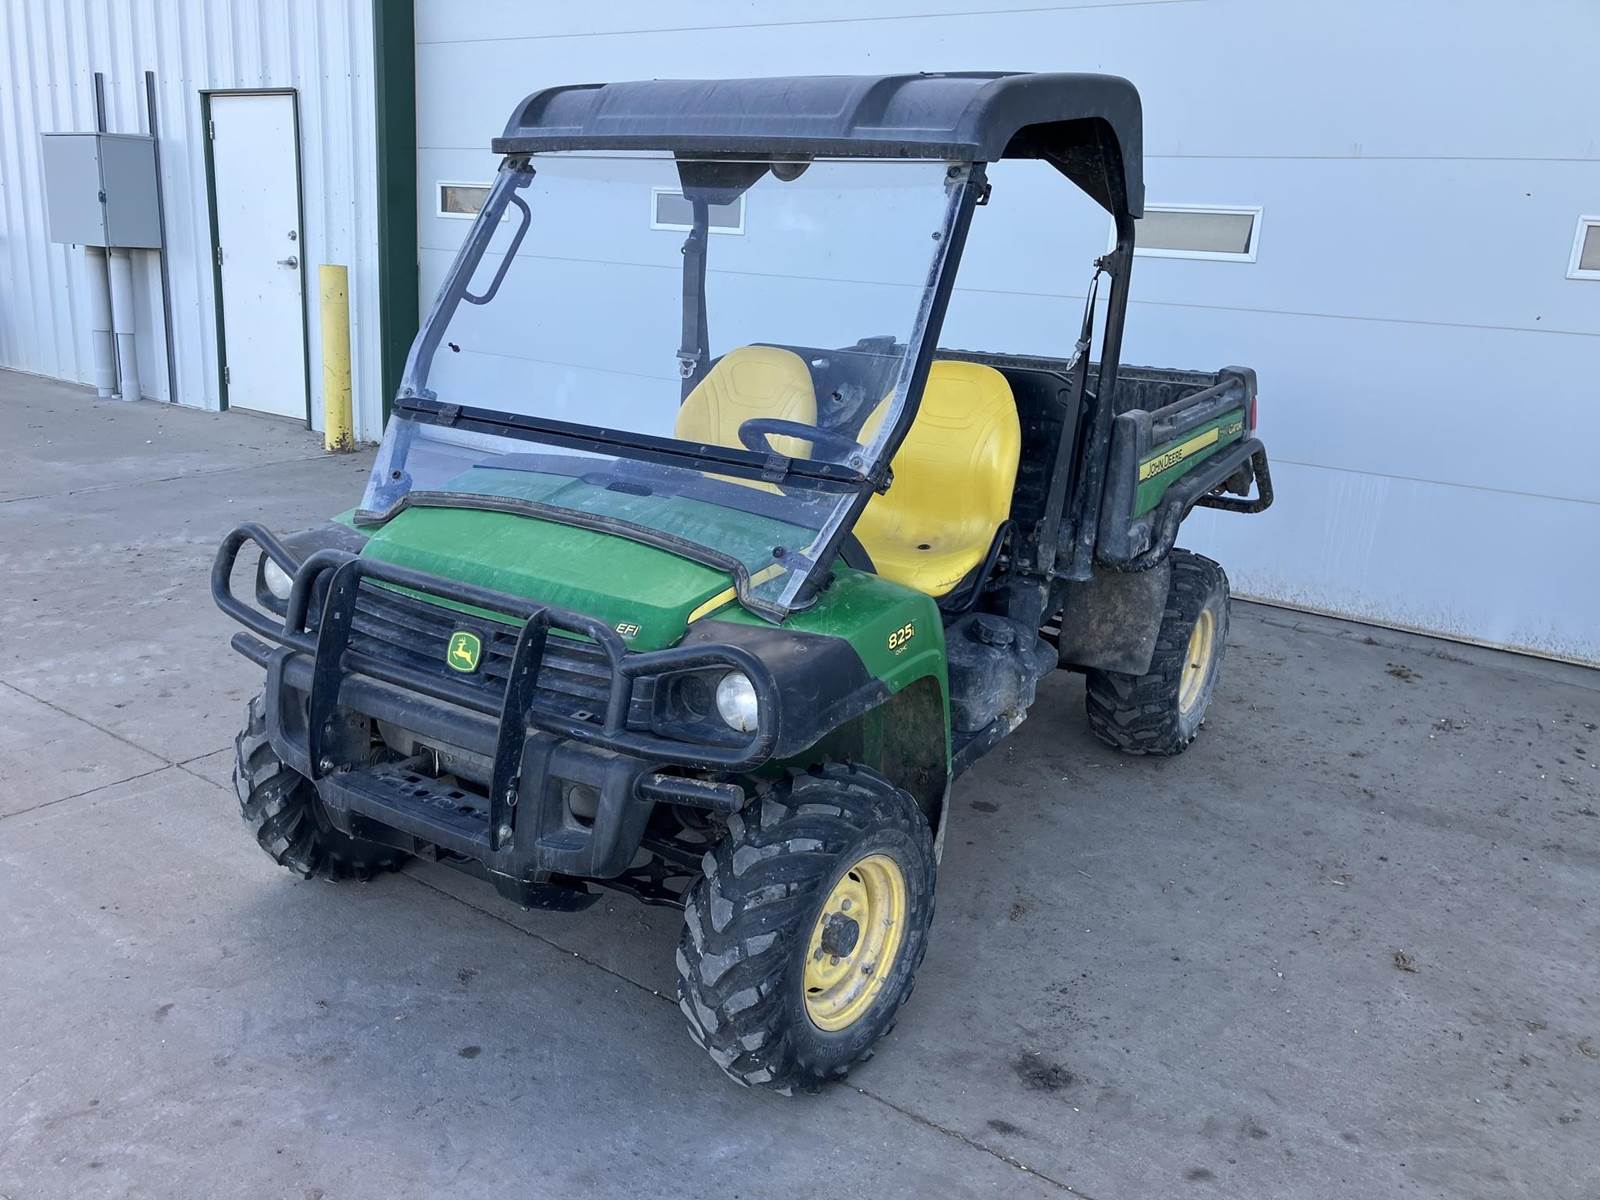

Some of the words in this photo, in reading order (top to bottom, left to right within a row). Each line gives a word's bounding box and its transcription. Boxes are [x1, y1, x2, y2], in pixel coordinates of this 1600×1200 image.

[1147, 459, 1164, 477] JOHN
[1164, 449, 1183, 468] DEERE
[616, 623, 639, 636] EFI
